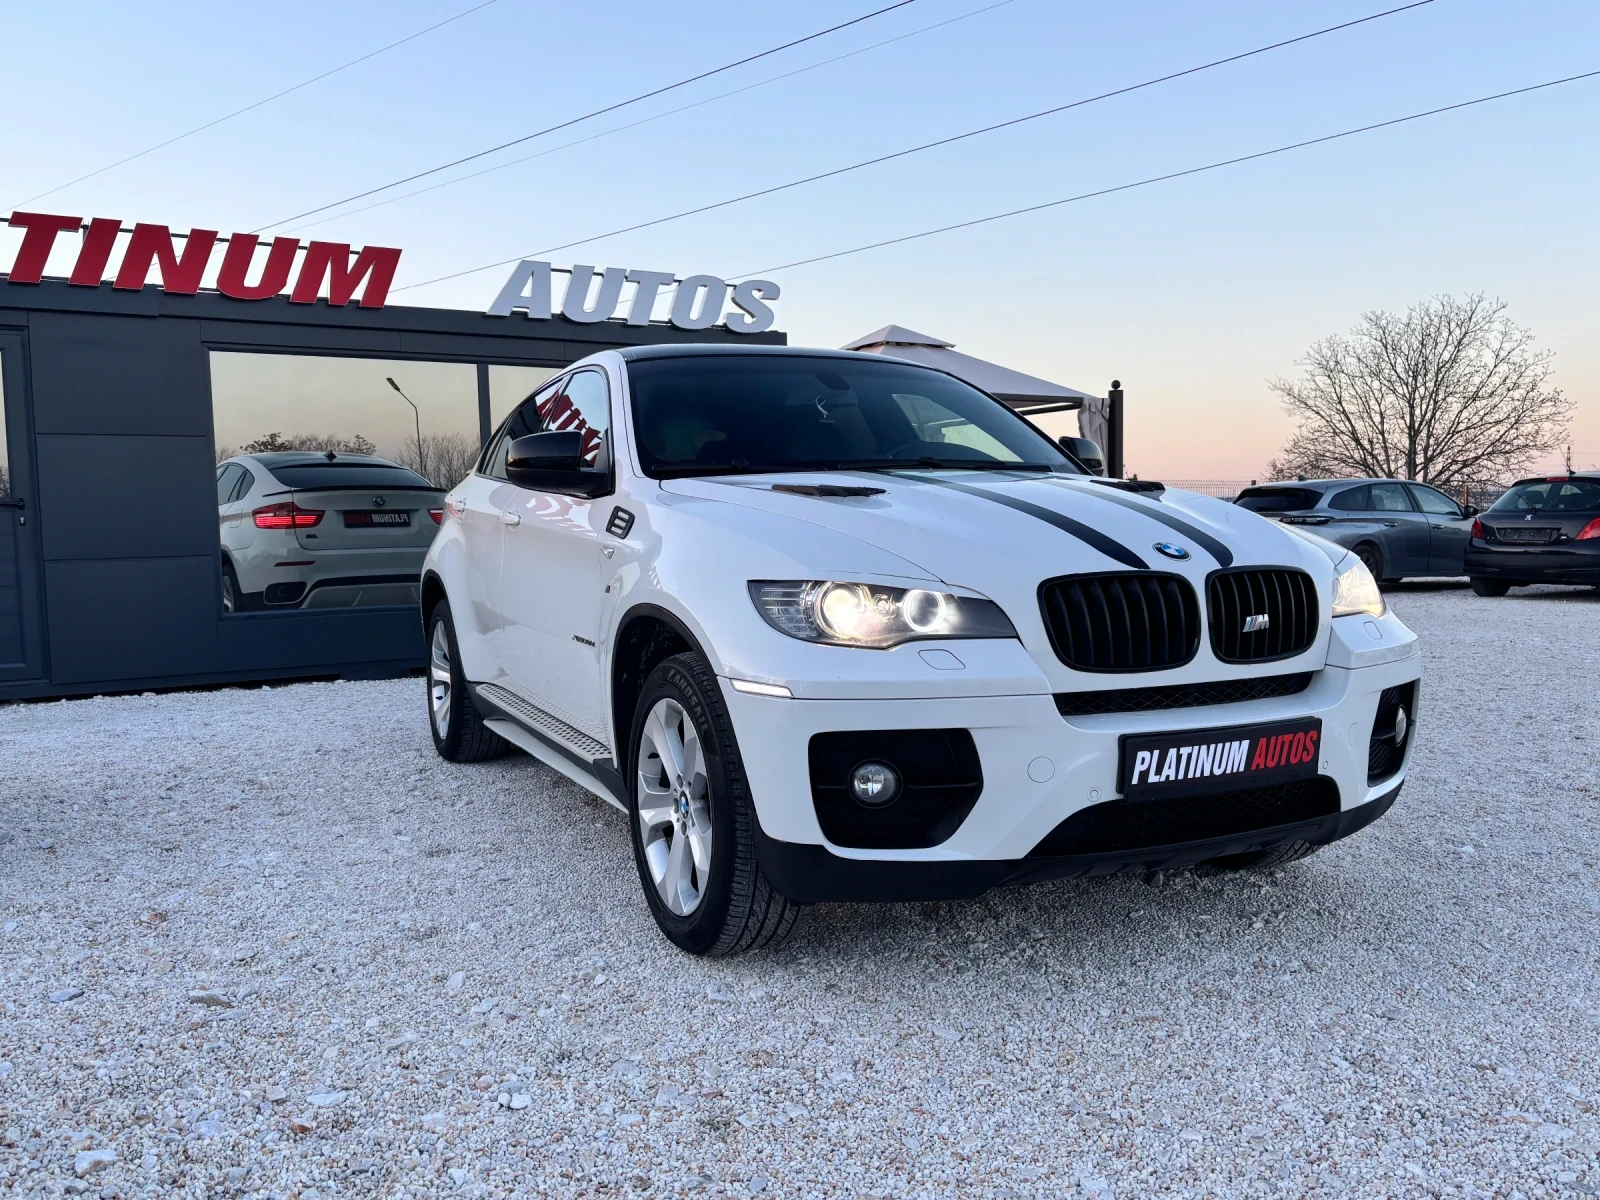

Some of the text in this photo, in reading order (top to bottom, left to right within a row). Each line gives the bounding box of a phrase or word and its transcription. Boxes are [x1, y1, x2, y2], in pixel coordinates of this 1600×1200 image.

[8, 211, 781, 333] TINUM AUTOS
[666, 669, 708, 736] LANDSAIL
[1132, 730, 1318, 785] PLATINUM AUTOS
